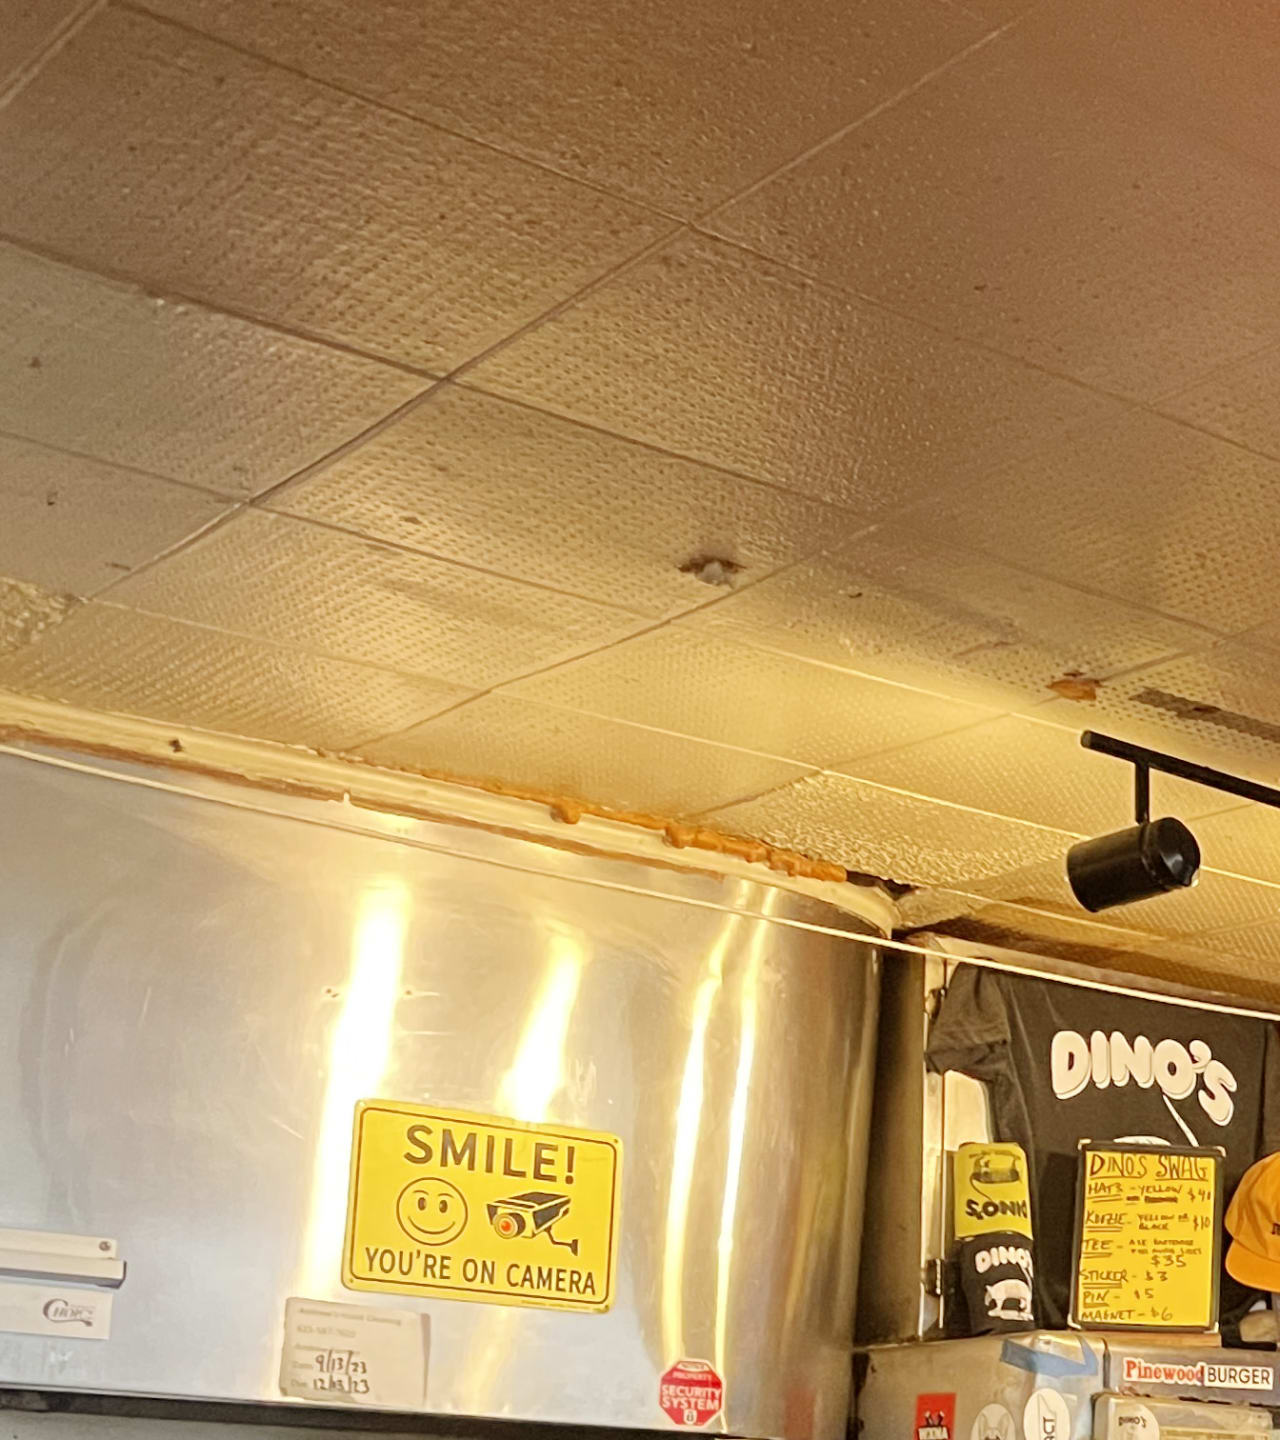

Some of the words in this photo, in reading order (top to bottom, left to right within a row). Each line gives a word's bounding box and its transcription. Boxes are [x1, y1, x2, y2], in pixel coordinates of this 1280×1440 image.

[1051, 1030, 1237, 1126] DINO'S
[403, 1124, 576, 1185] SMILE!
[1155, 1155, 1208, 1179] SWAG
[1083, 1239, 1114, 1250] TEE
[1151, 1255, 1186, 1267] $35
[365, 1247, 451, 1280] YOU'RE
[462, 1259, 495, 1286] ON
[507, 1264, 596, 1295] CAMERA
[1079, 1270, 1128, 1282] STICKER
[1144, 1271, 1168, 1281] $3
[1083, 1291, 1110, 1302] PIN
[1082, 1310, 1135, 1320] MAGNET
[1151, 1307, 1173, 1320] $6
[315, 1349, 368, 1375] 9/13/23
[1125, 1360, 1204, 1383] Pinewood
[1208, 1367, 1270, 1384] BURGER
[662, 1384, 722, 1401] SECURITY
[662, 1395, 720, 1411] SYSTEM
